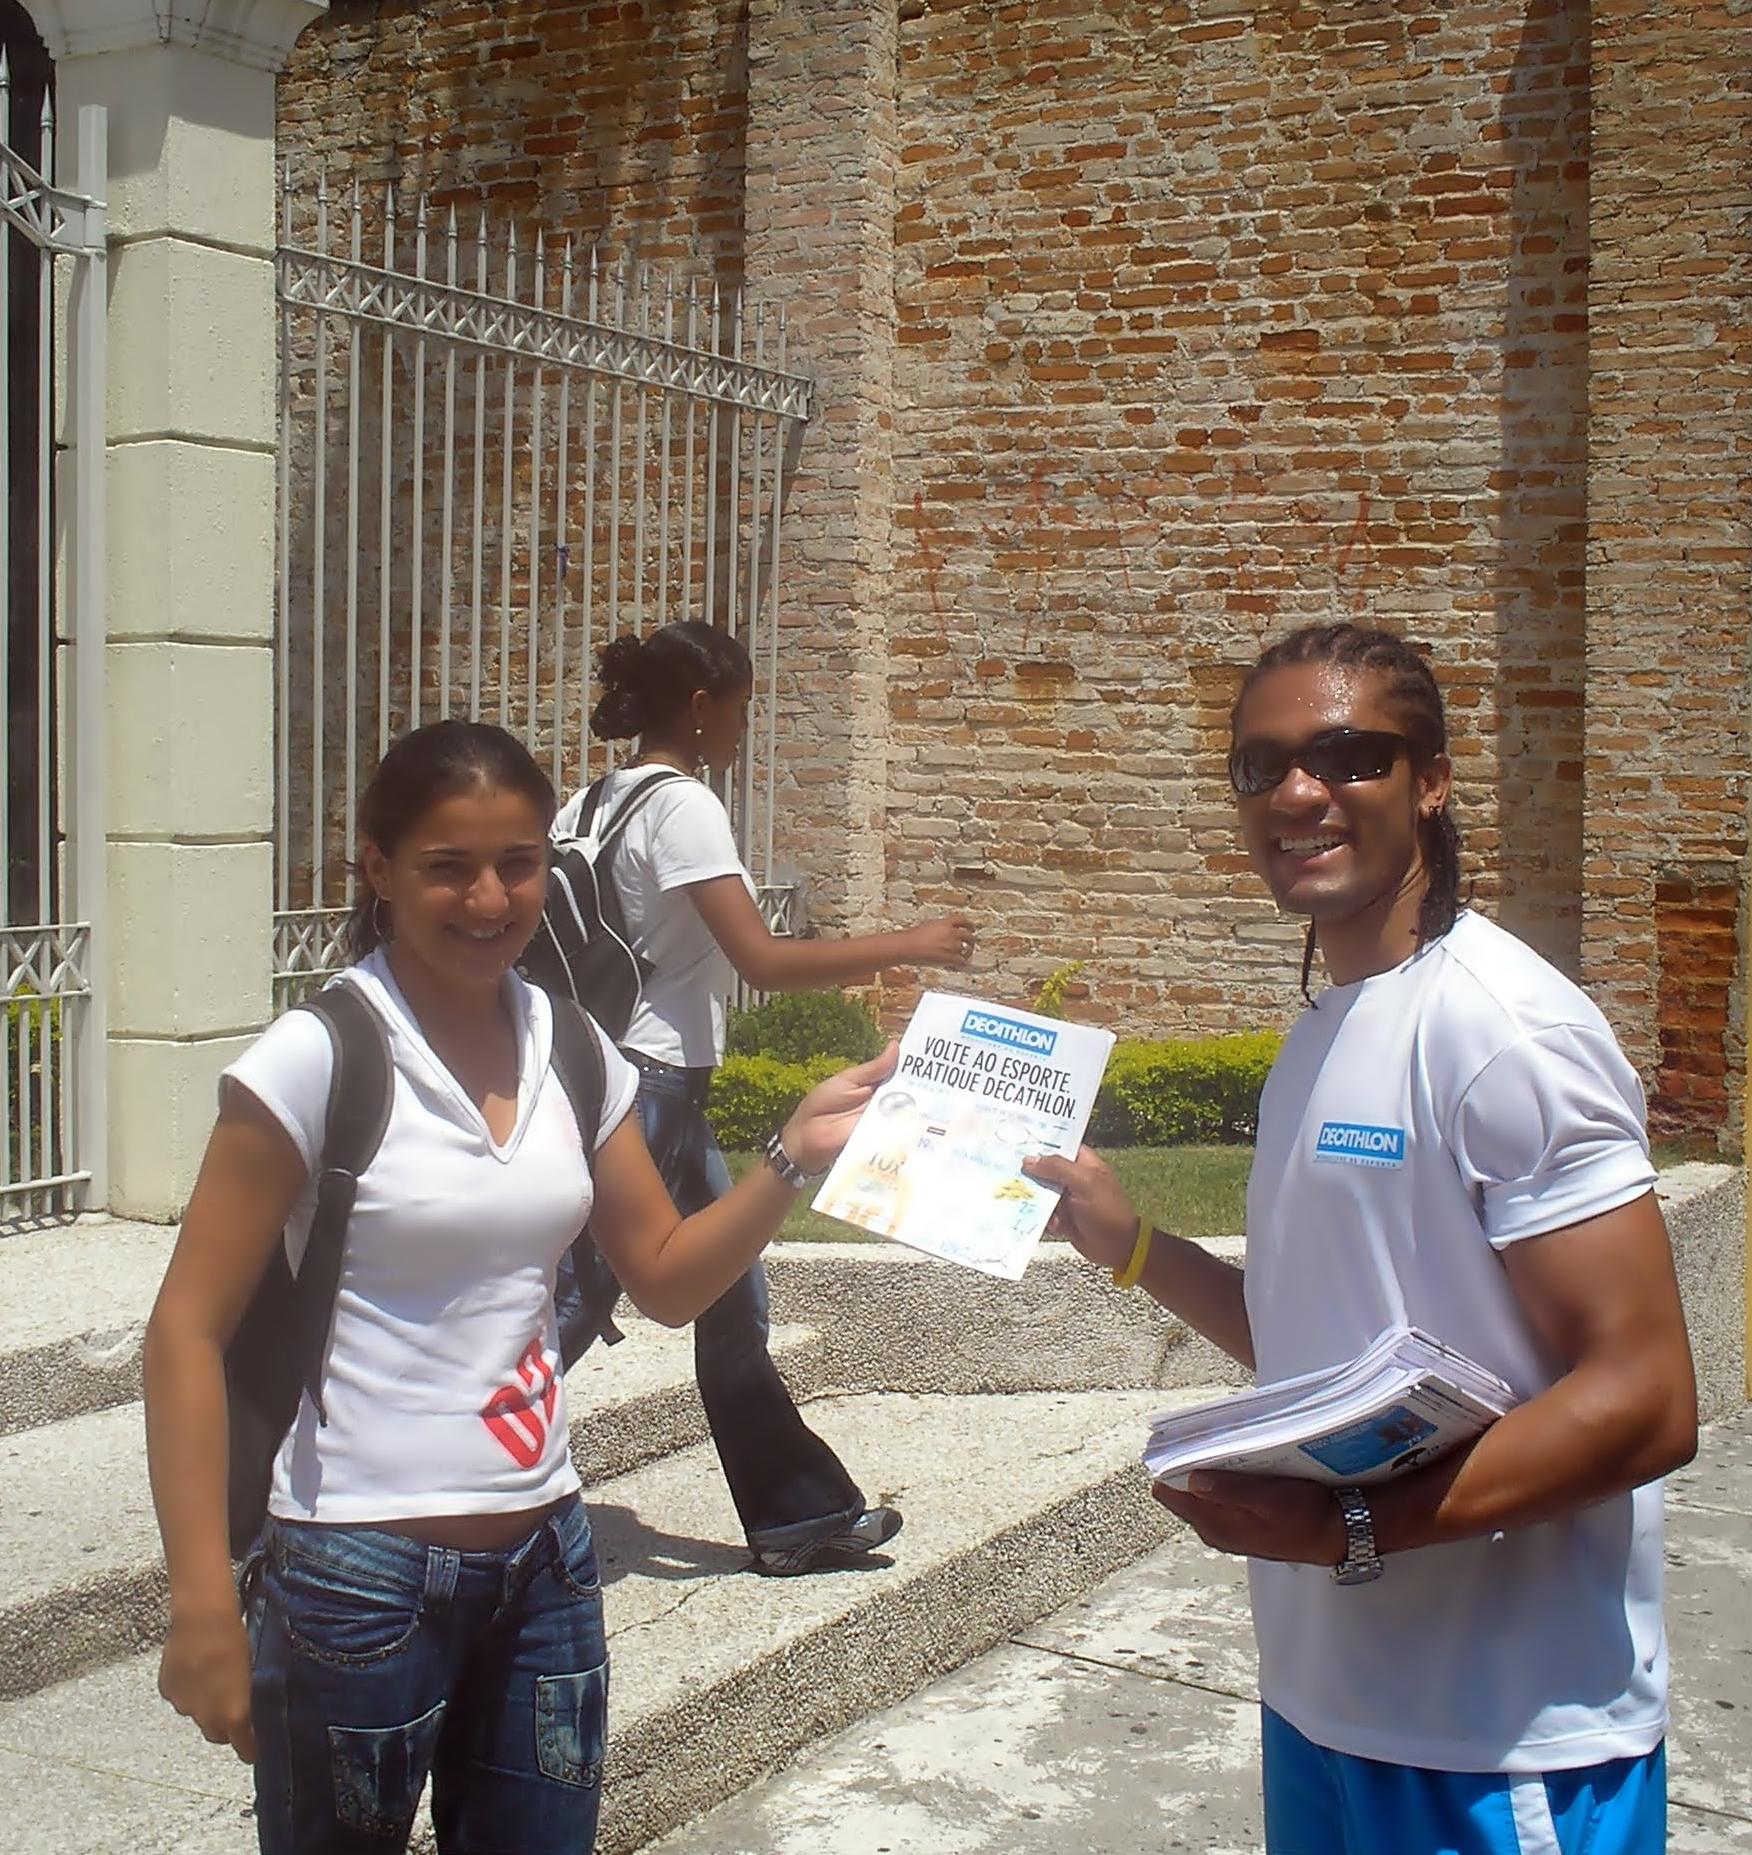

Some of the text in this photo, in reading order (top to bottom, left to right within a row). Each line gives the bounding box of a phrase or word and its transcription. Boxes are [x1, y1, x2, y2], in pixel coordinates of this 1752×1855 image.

[962, 1014, 1054, 1051] DECATHLON
[901, 1055, 981, 1093] PRATIQUE
[982, 1077, 1077, 1120] DECATHLON.
[924, 1036, 971, 1065] VOLTE
[972, 1050, 997, 1072] AO
[1000, 1057, 1071, 1094] ESPORTE.
[1319, 1127, 1398, 1153] DECATHLON
